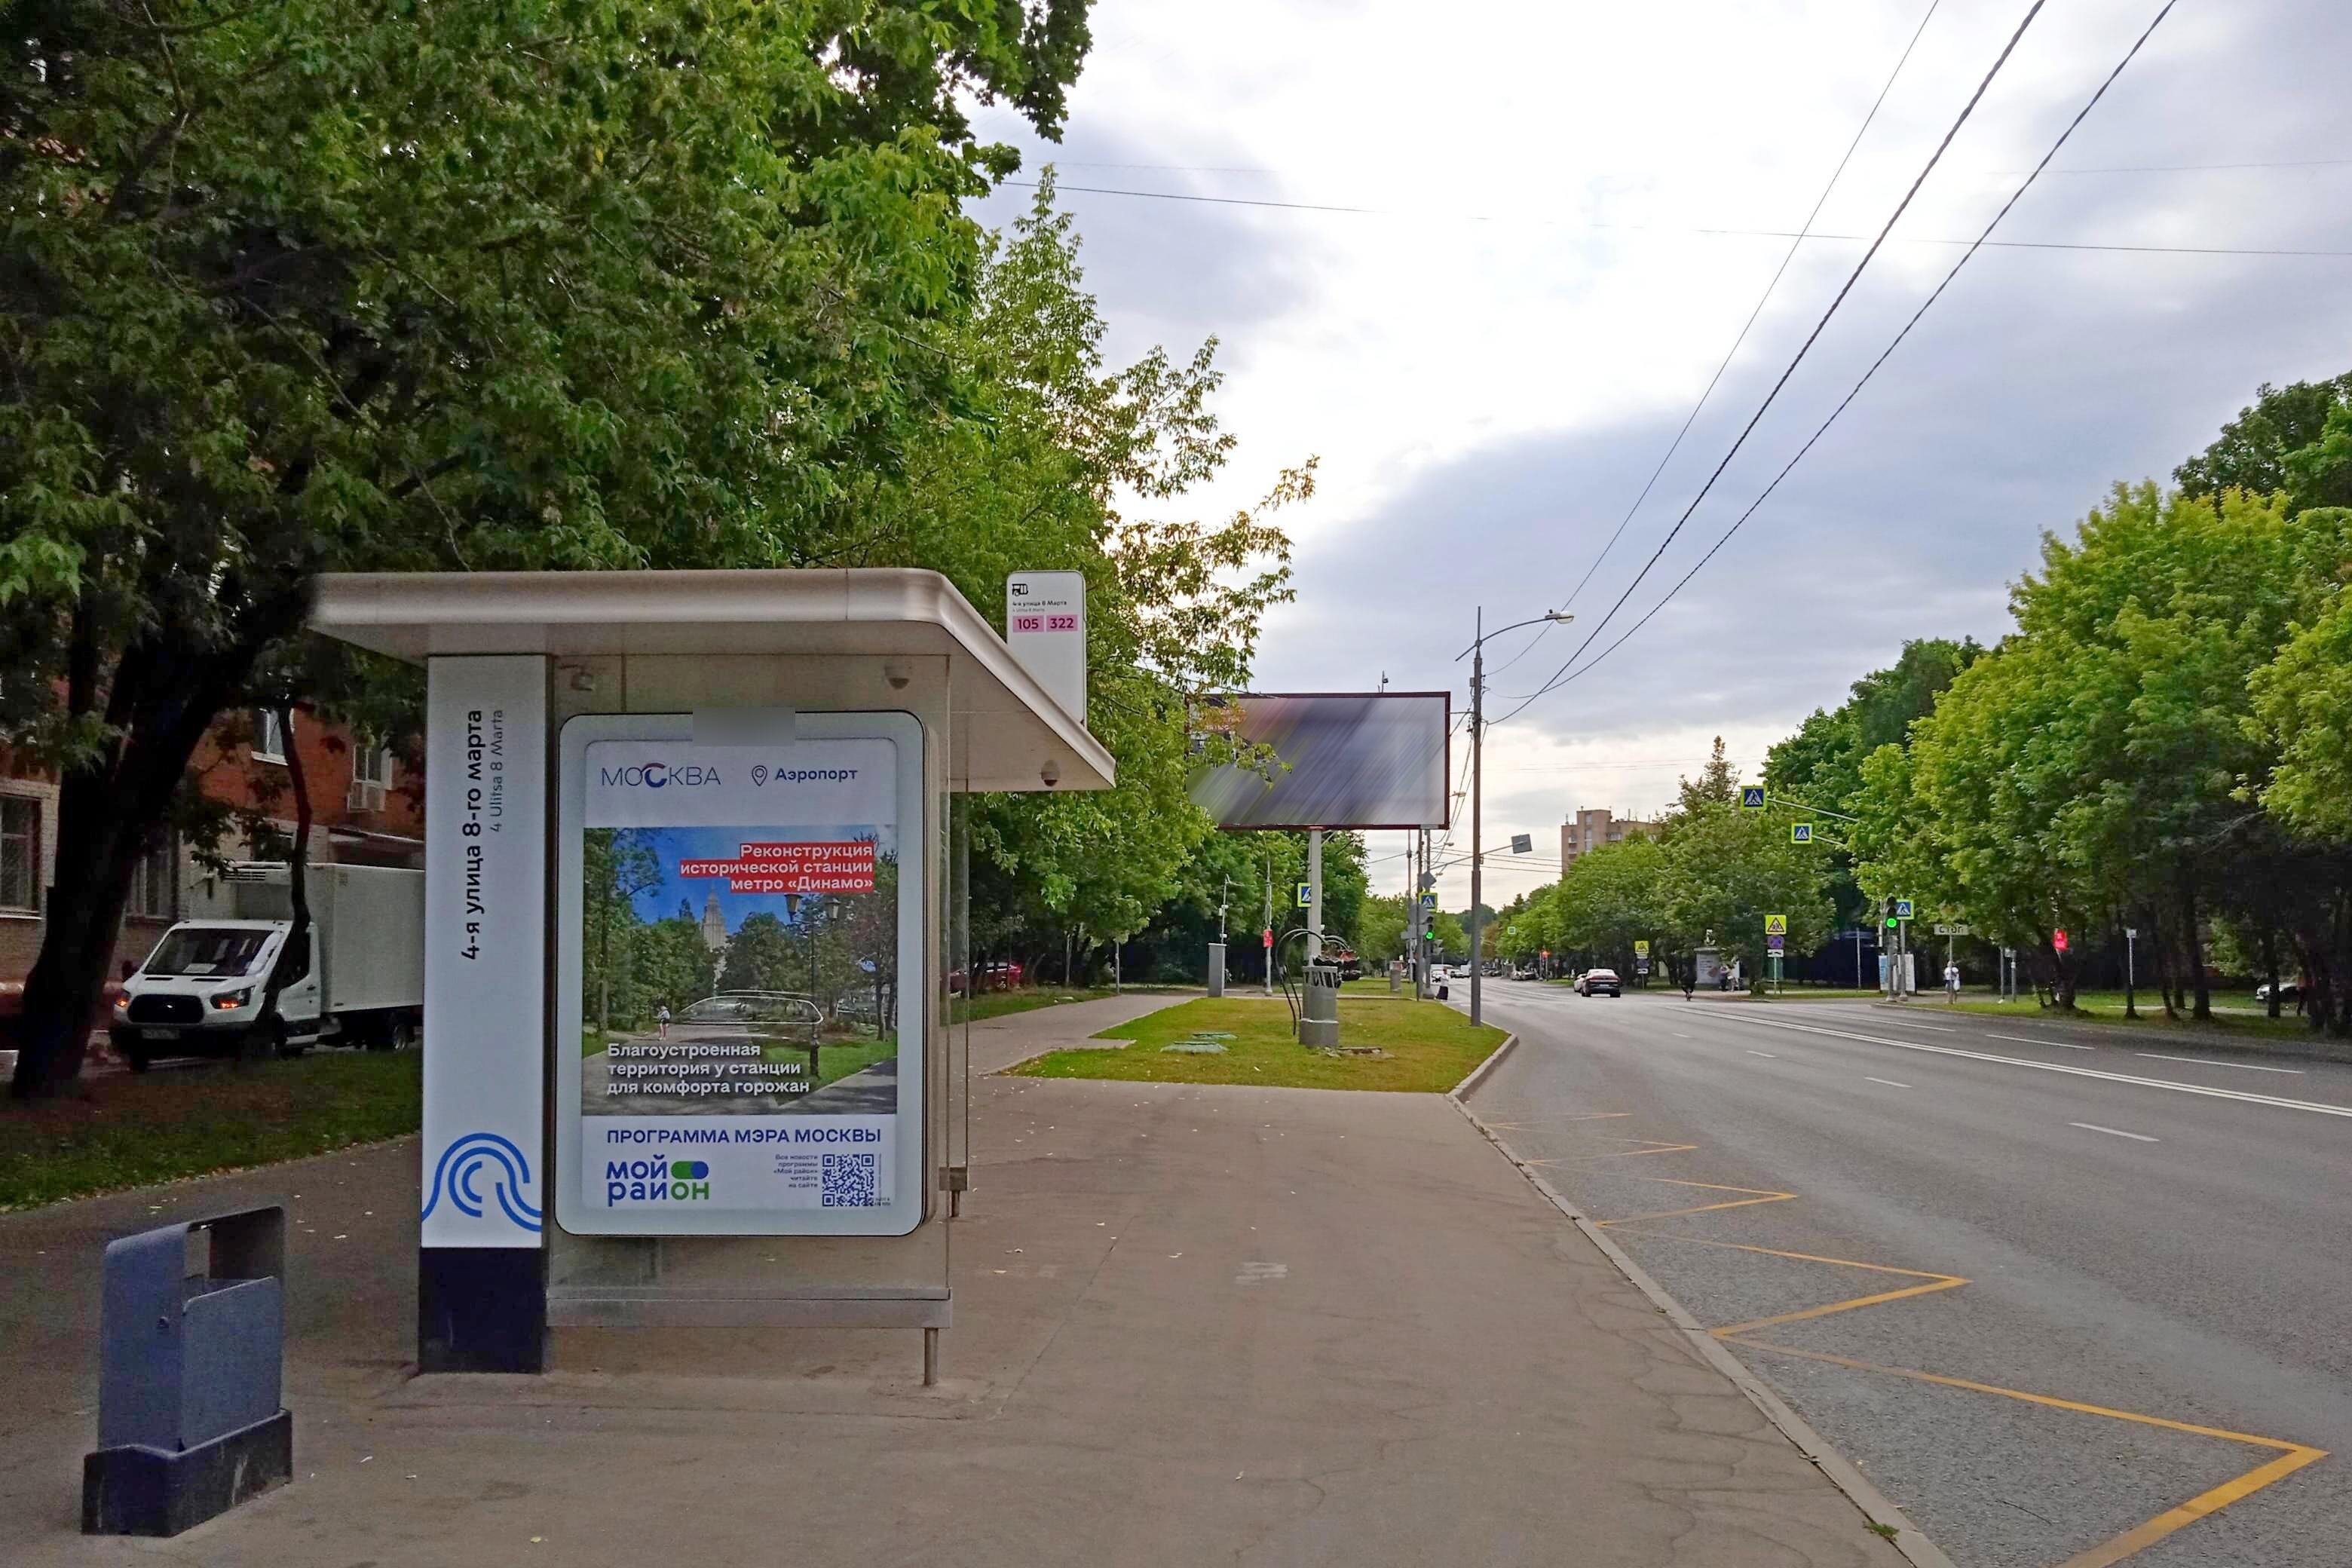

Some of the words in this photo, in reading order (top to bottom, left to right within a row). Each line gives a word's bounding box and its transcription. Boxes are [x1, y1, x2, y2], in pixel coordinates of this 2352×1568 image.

[1018, 619, 1039, 629] 105
[1050, 618, 1073, 629] 322
[491, 710, 503, 756] Marta
[468, 710, 486, 781] марта
[490, 761, 503, 770] 8
[601, 762, 721, 789] МОСКВА
[775, 767, 858, 782] Аэропорт
[490, 776, 503, 817] Ulitsa
[462, 788, 482, 837] 8-го
[490, 822, 501, 832] 4
[740, 844, 874, 859] Реконструкция
[681, 860, 798, 877] исторической
[803, 862, 873, 876] станции
[466, 845, 485, 914] улица
[730, 879, 783, 893] метро
[788, 877, 874, 891] «Динамо»
[461, 922, 480, 960] 4-я
[608, 1043, 761, 1060] Благоустроенная
[608, 1062, 709, 1078] территория
[715, 1064, 724, 1077] у
[729, 1062, 800, 1076] станции
[607, 1082, 638, 1095] для
[643, 1080, 730, 1096] комфорта
[734, 1081, 810, 1094] горожан
[607, 1129, 730, 1144] ПРОГРАММА
[735, 1129, 790, 1143] МЭРА
[795, 1129, 880, 1143] МОСКВЫ
[606, 1154, 667, 1179] мой
